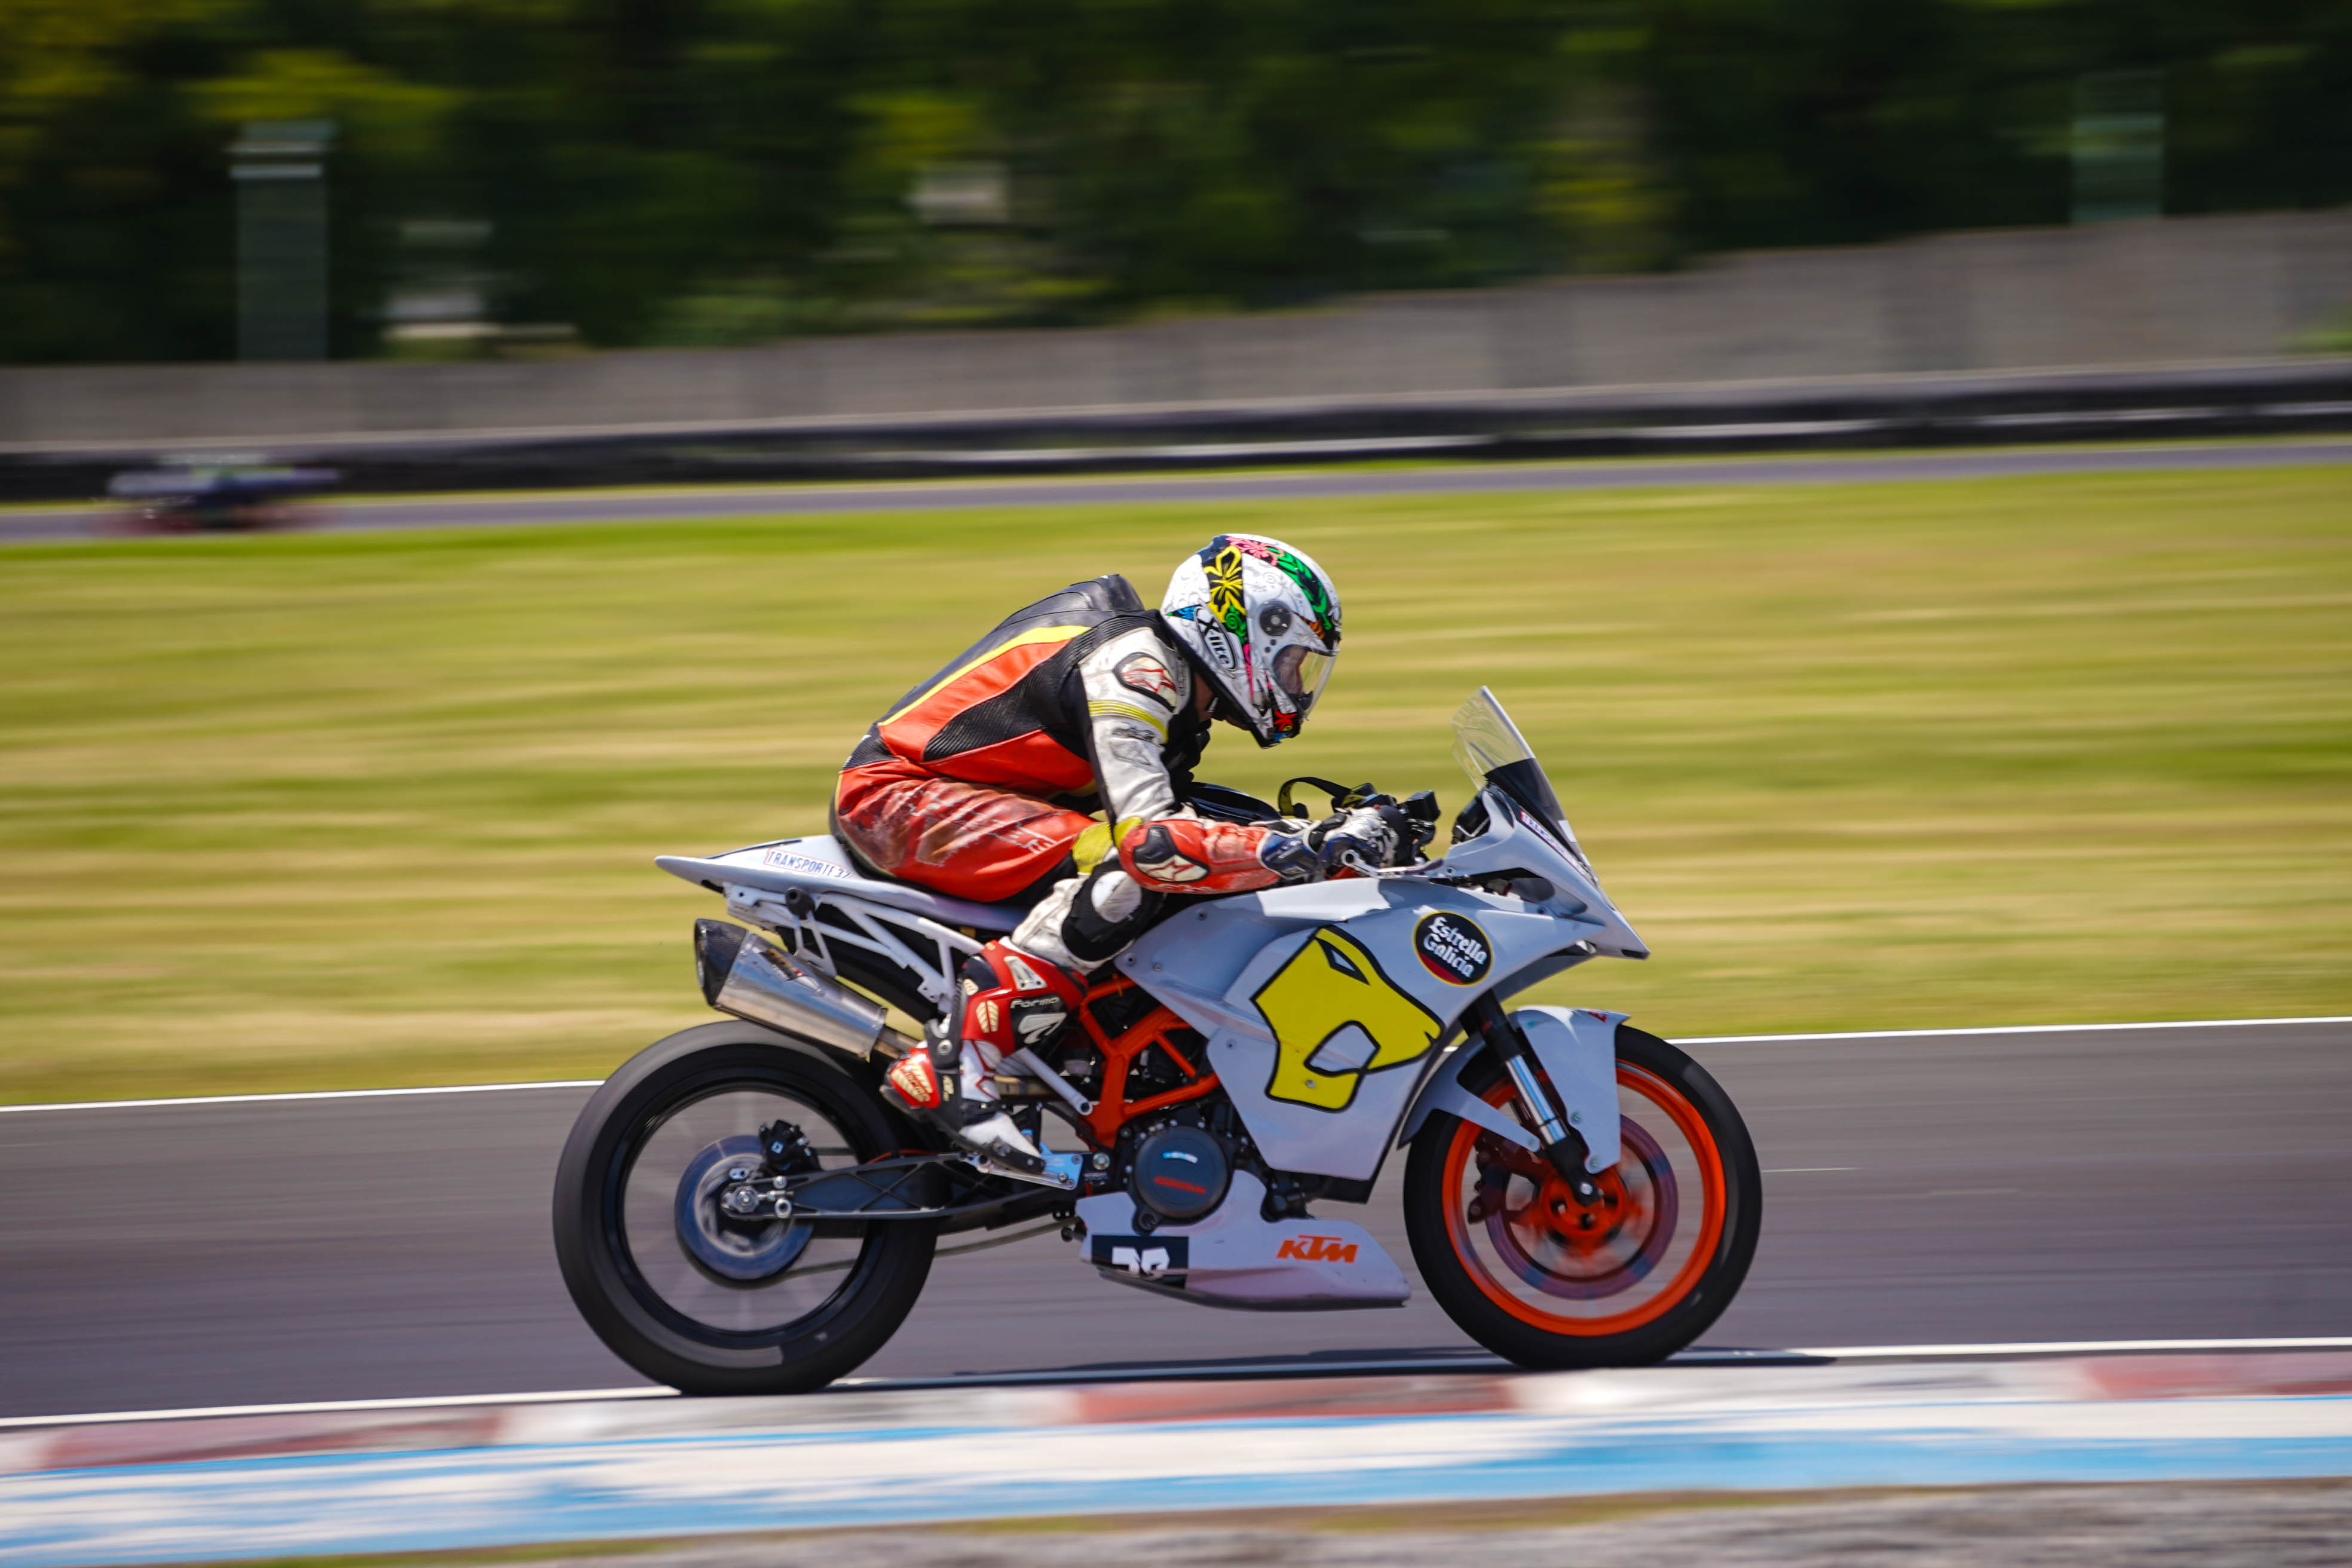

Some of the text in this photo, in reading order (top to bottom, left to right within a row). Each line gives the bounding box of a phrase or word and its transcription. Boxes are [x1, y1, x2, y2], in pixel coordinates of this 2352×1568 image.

[1423, 933, 1474, 978] Galicia
[1428, 917, 1487, 964] Estrella
[1276, 1235, 1358, 1264] KTM
